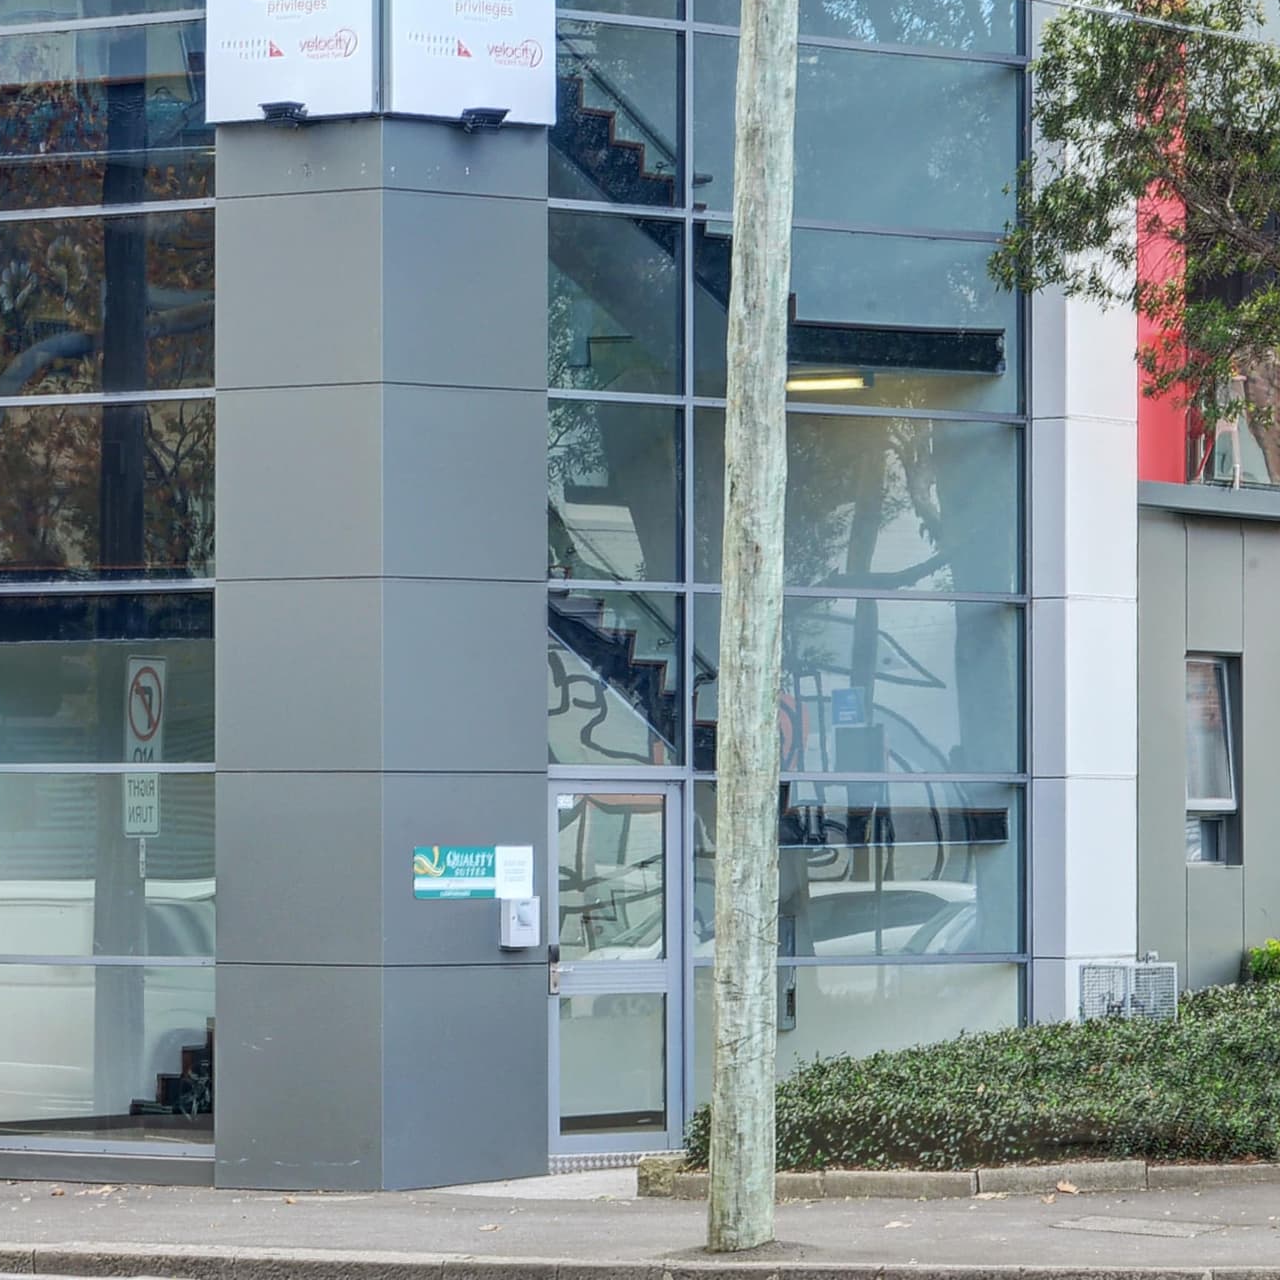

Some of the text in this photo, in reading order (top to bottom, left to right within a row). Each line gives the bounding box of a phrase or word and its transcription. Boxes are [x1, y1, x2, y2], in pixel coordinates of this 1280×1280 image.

[455, 0, 514, 18] privileges
[487, 39, 544, 67] velocity
[446, 851, 494, 869] QUALITY
